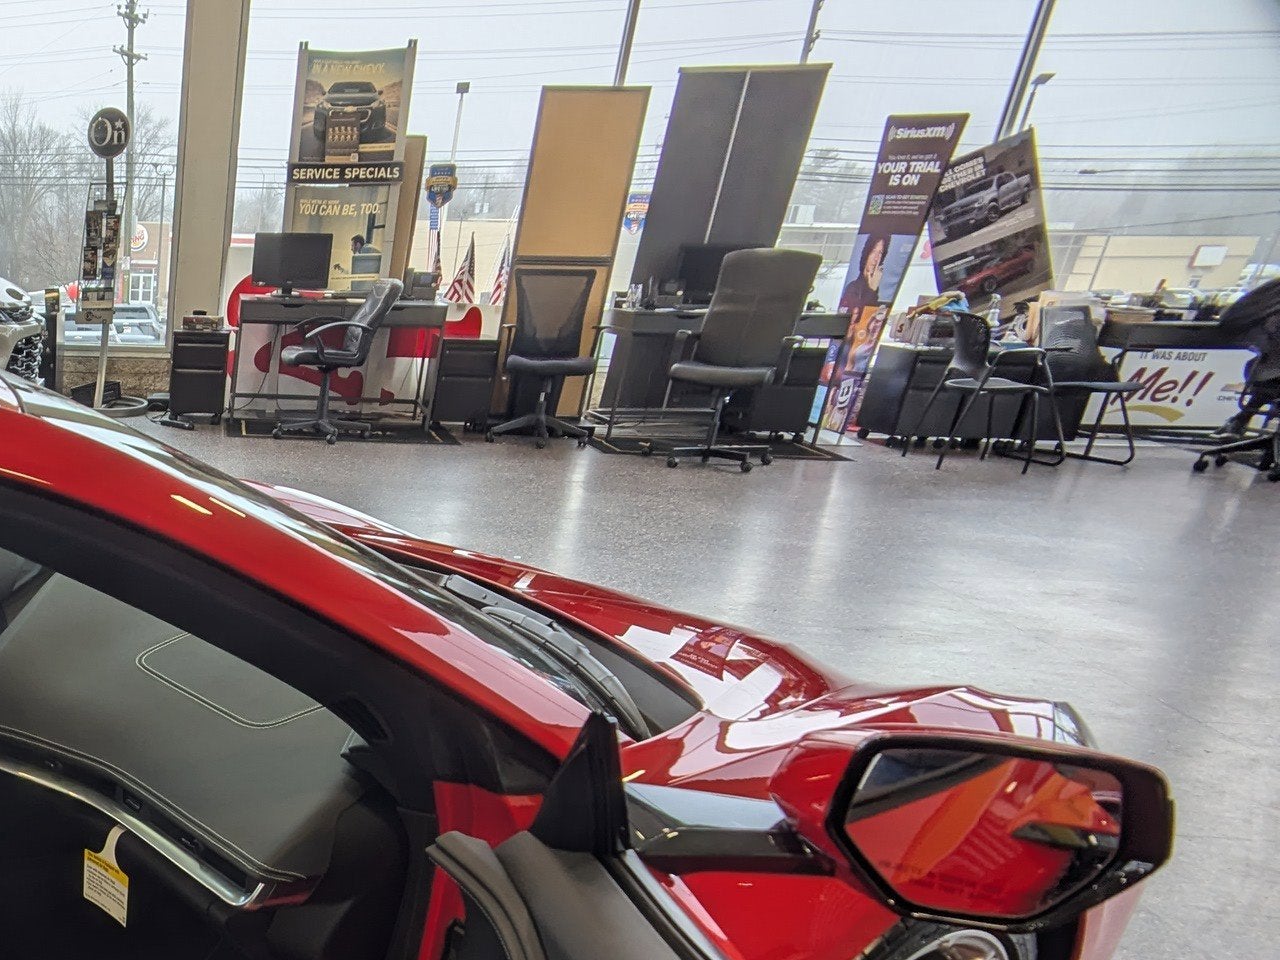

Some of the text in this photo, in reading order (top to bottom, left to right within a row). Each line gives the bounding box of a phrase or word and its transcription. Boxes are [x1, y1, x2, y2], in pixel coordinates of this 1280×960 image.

[90, 117, 126, 147] On
[292, 167, 400, 180] SERVICE SPECIALS
[877, 161, 941, 174] YOUR TRIAL
[888, 174, 921, 186] IS ON
[300, 203, 380, 217] YOU CAN BE, TOO.
[1151, 351, 1173, 360] WAS
[1174, 352, 1207, 361] ABOUT
[1110, 366, 1216, 407] Me!!
